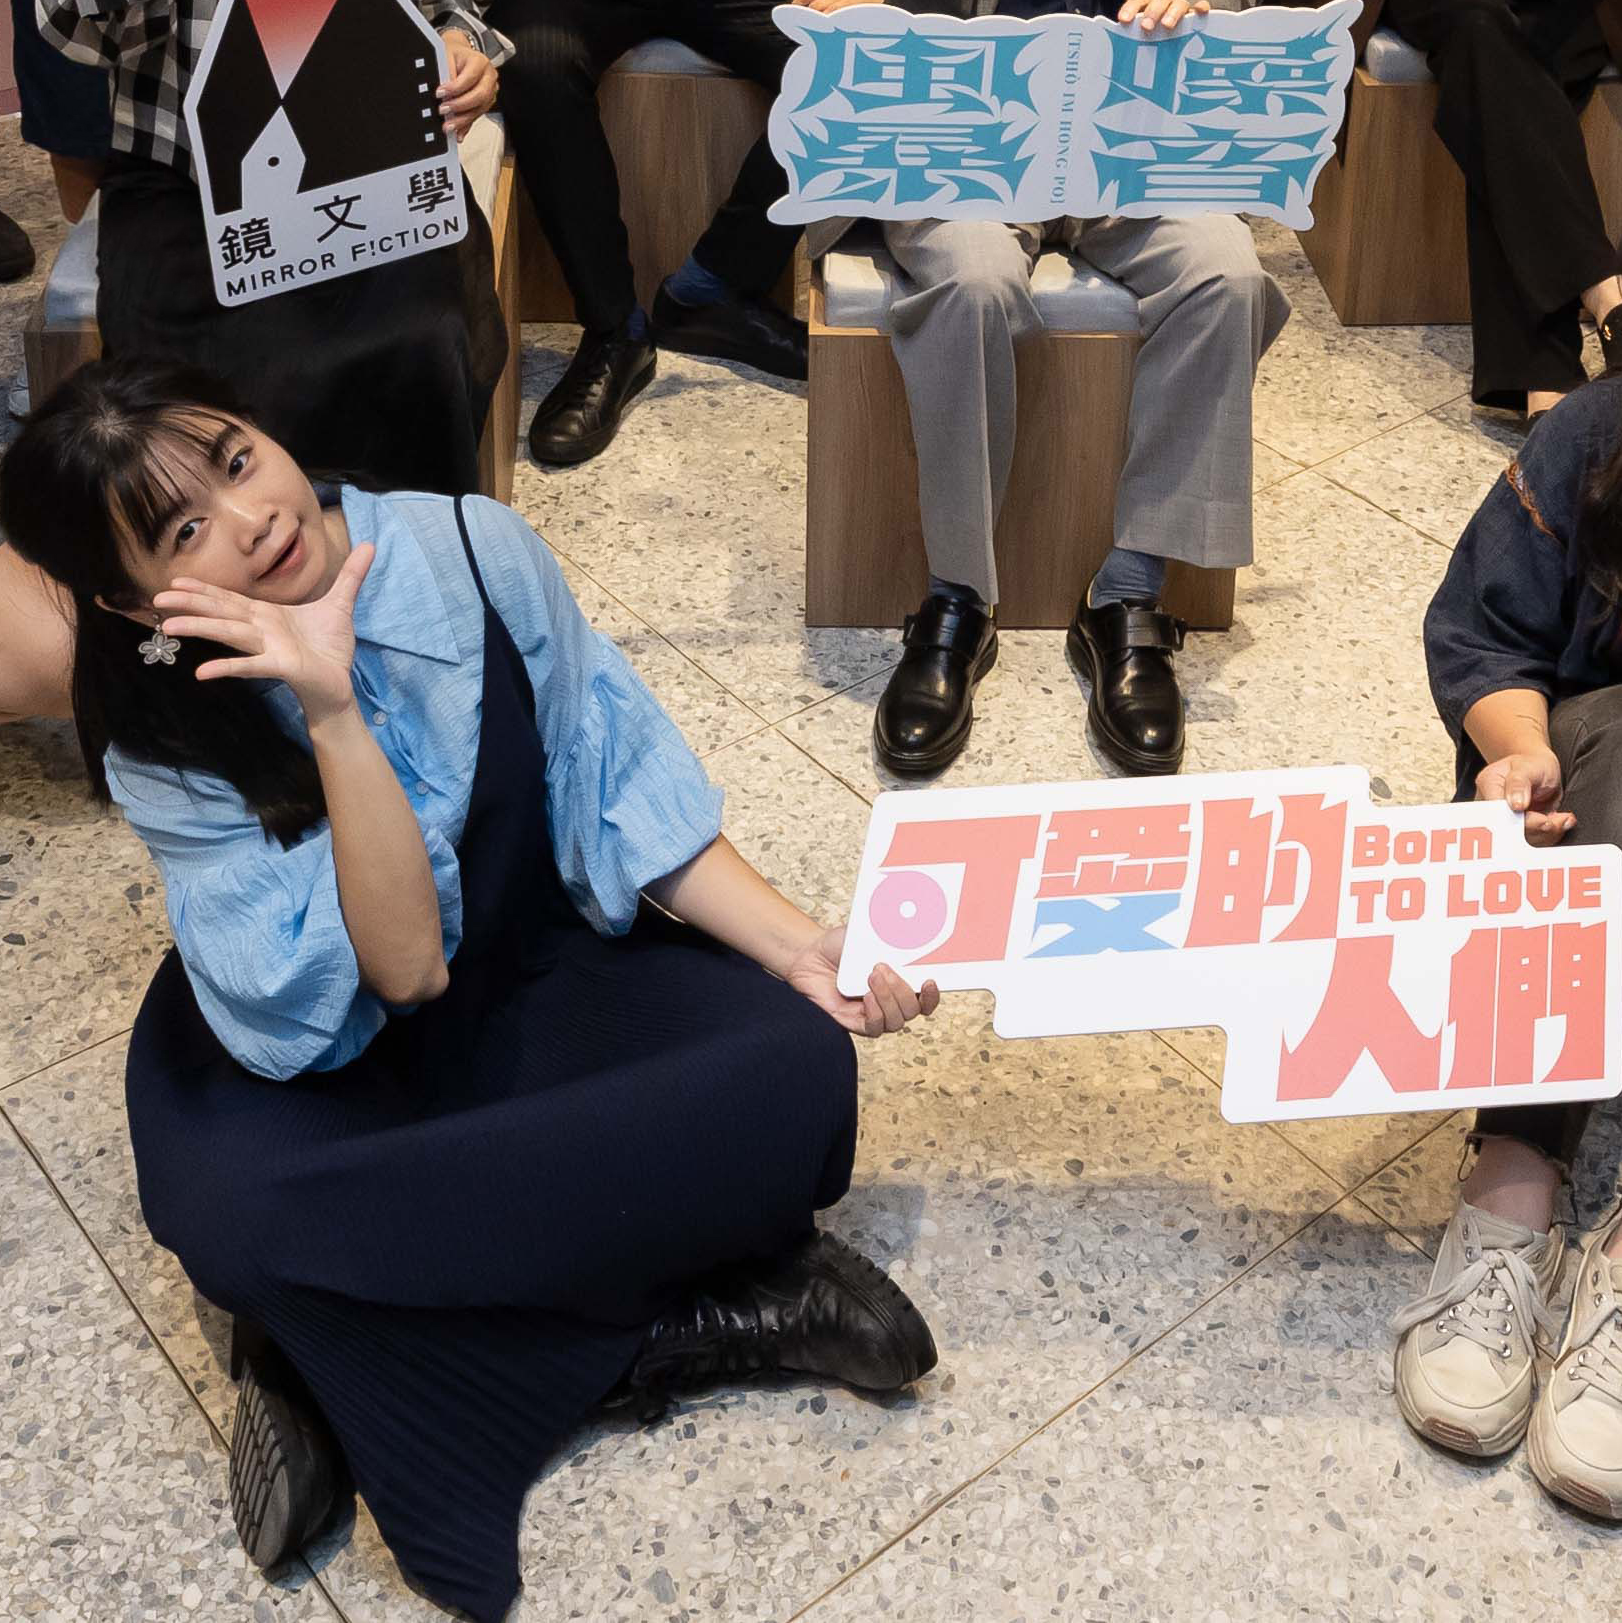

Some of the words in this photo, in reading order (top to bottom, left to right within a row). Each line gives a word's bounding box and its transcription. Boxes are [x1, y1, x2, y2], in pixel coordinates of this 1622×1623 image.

[217, 166, 455, 270] 鏡文學
[226, 252, 337, 297] MIRROR
[867, 792, 1349, 968] 可愛的
[1349, 876, 1427, 924] TO
[1446, 865, 1603, 919] LOVE
[1275, 919, 1608, 1103] 人們
